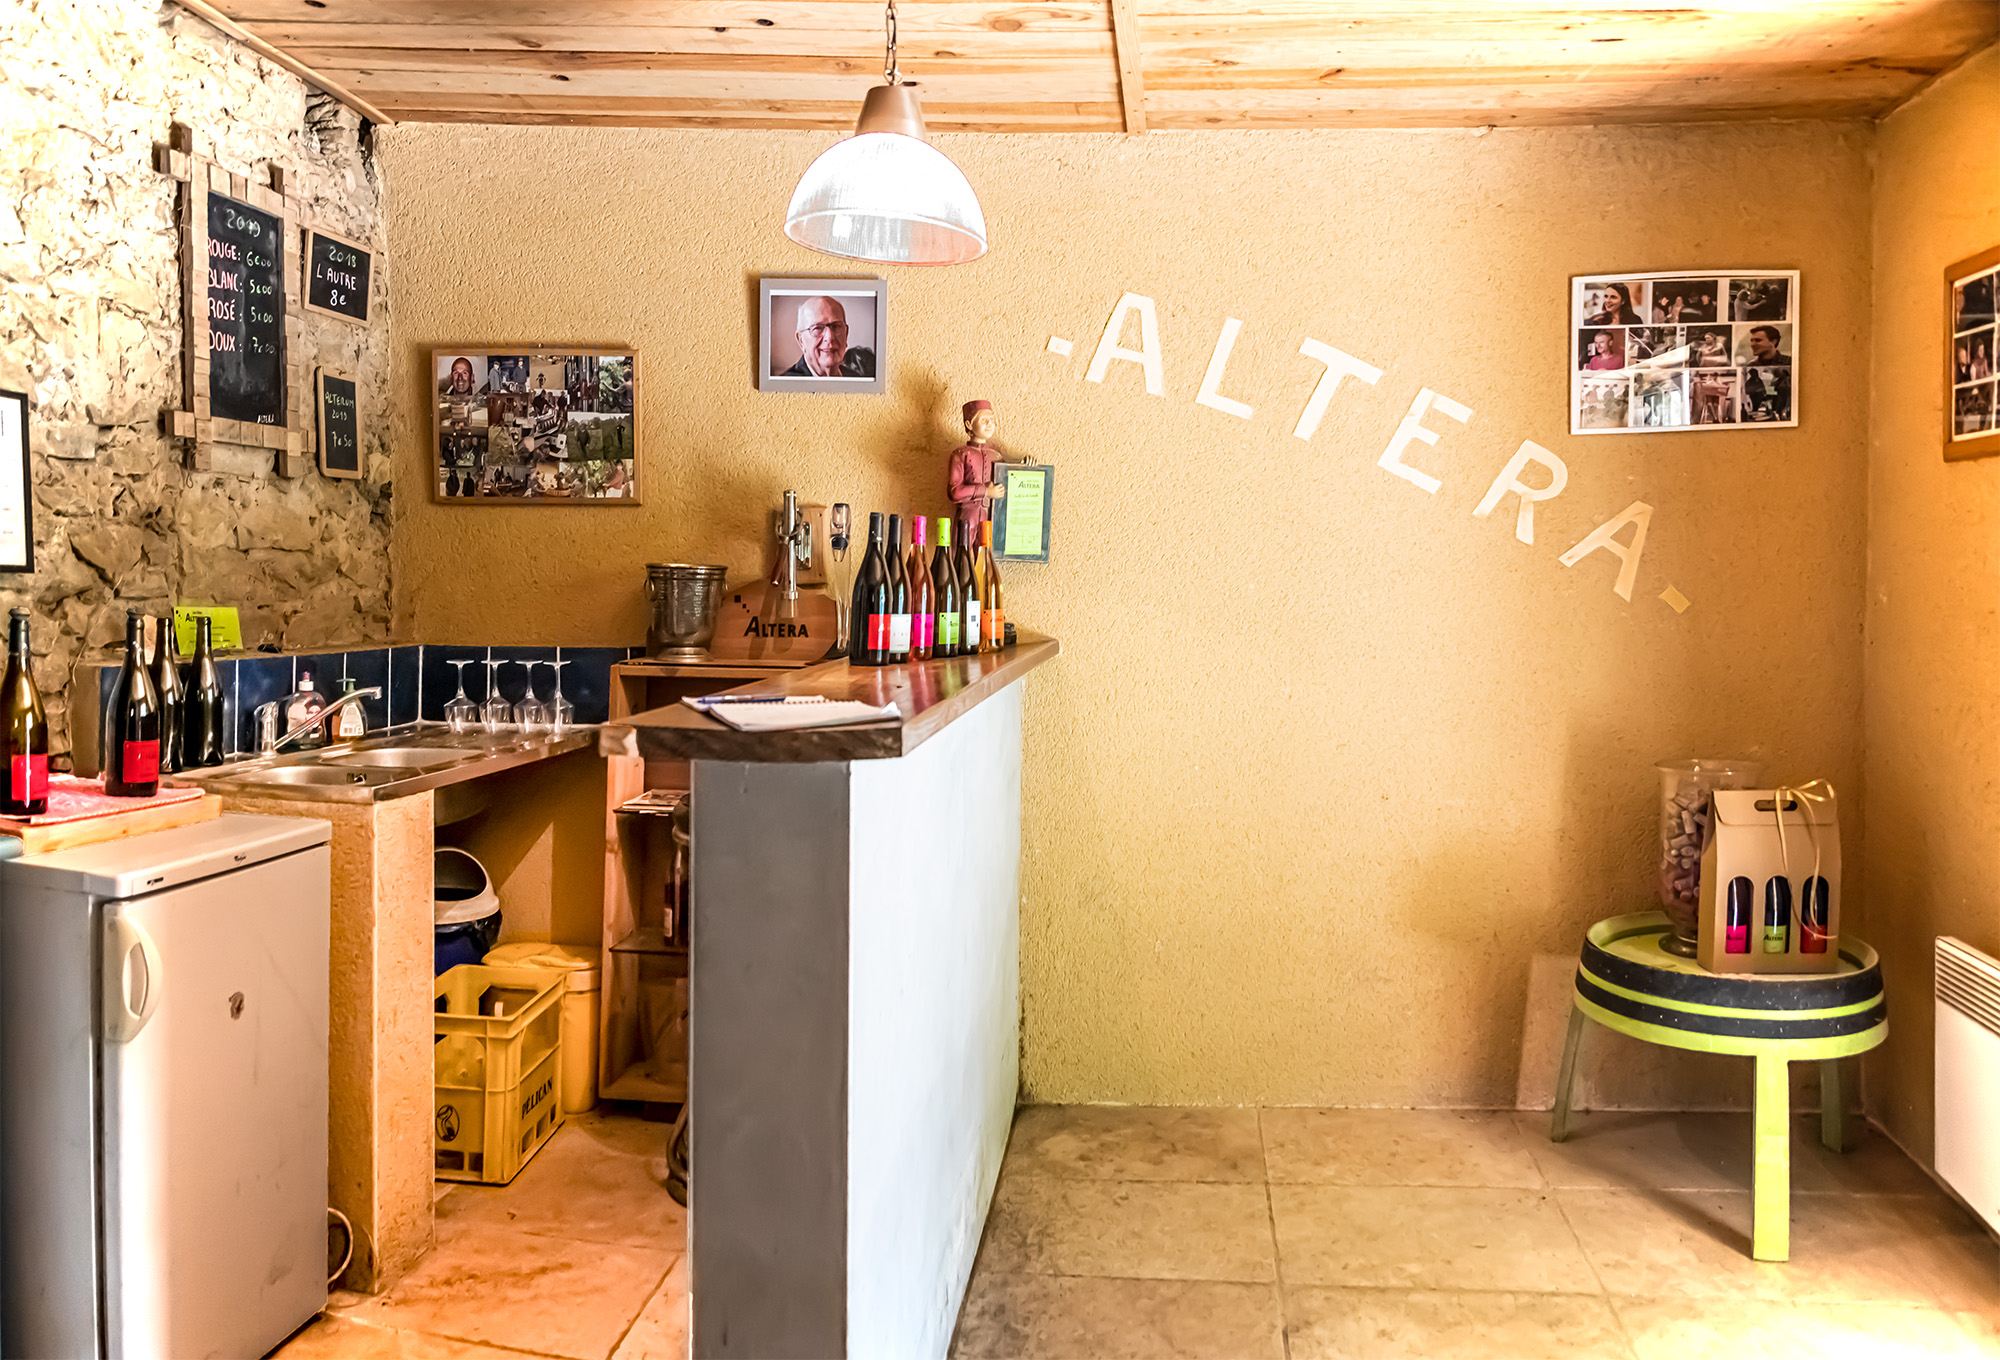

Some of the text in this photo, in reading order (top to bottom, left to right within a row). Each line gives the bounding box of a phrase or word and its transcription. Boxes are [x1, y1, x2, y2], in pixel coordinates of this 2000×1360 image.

[329, 245, 357, 269] 2018
[326, 267, 357, 291] AUTRE
[743, 615, 810, 638] ALTERA
